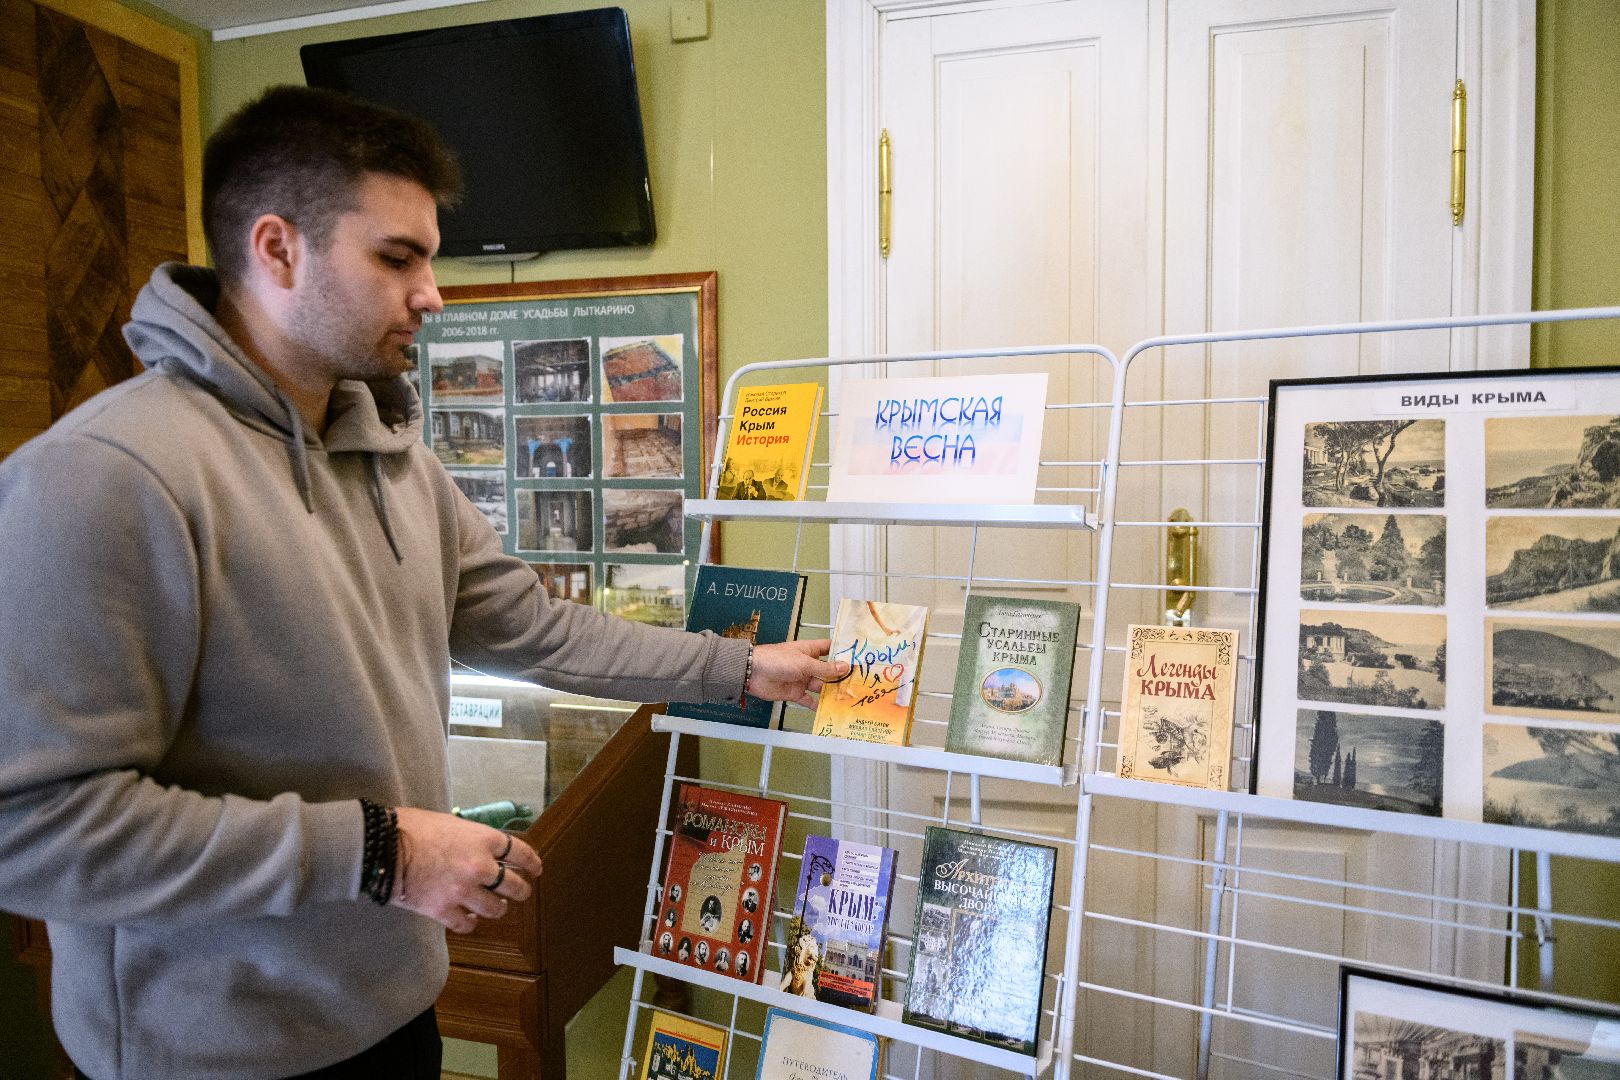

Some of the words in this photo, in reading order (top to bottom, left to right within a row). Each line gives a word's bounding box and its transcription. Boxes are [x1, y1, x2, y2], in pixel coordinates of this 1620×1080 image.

[442, 311, 488, 323] ГЛАВНОМ
[489, 309, 519, 322] ДОМЕ
[523, 306, 569, 320] УСАДЬБЫ
[572, 304, 635, 317] ЛЫТКАРИНО
[441, 326, 487, 337] 2006-2018
[1401, 394, 1459, 408] ВИДЫ
[1471, 391, 1547, 404] КРЫМА
[742, 406, 787, 418] Россия
[875, 395, 1003, 424] КРЫМСКАЯ
[739, 420, 775, 433] Крым
[736, 434, 790, 447] История
[890, 434, 976, 460] ВЕСНА
[706, 581, 719, 595] А.
[724, 583, 788, 601] БУШКОВ
[987, 638, 1046, 654] УСАДЬБЫ
[992, 652, 1037, 666] КРЫМА
[1136, 654, 1219, 684] Легенды
[1140, 679, 1216, 700] КРЫМА
[451, 703, 500, 720] ЕСТАВРАЦИИ
